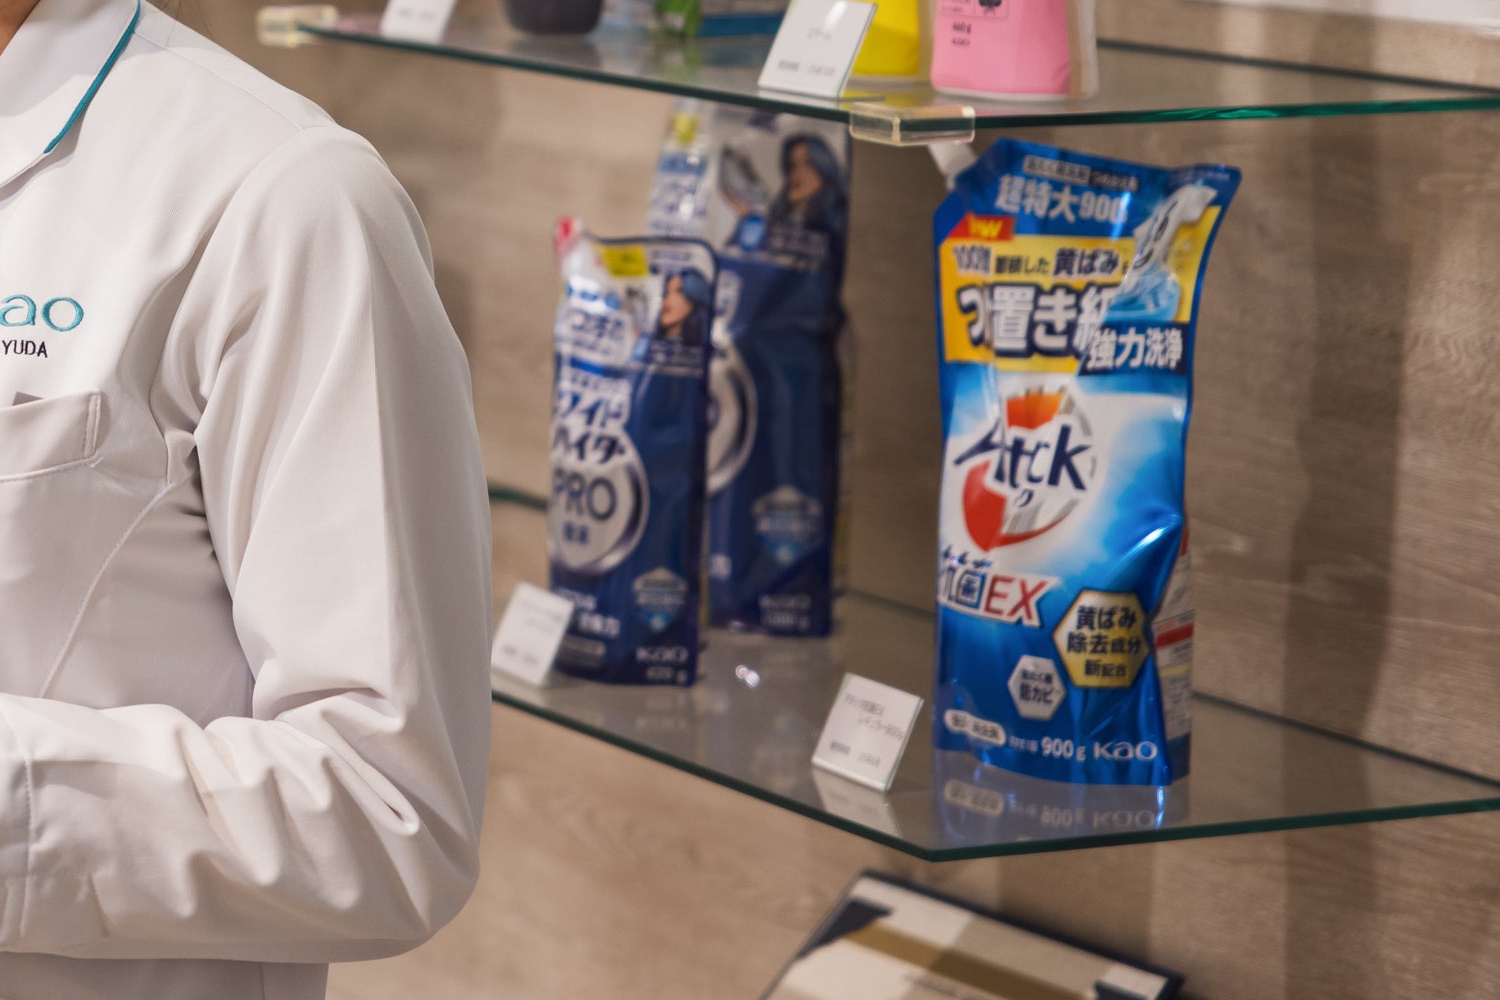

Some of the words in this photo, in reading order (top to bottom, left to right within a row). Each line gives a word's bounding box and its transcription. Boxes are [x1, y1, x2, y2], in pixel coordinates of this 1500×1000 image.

[1075, 604, 1137, 630] 黄ばみ
[1066, 632, 1142, 655] 除去成分
